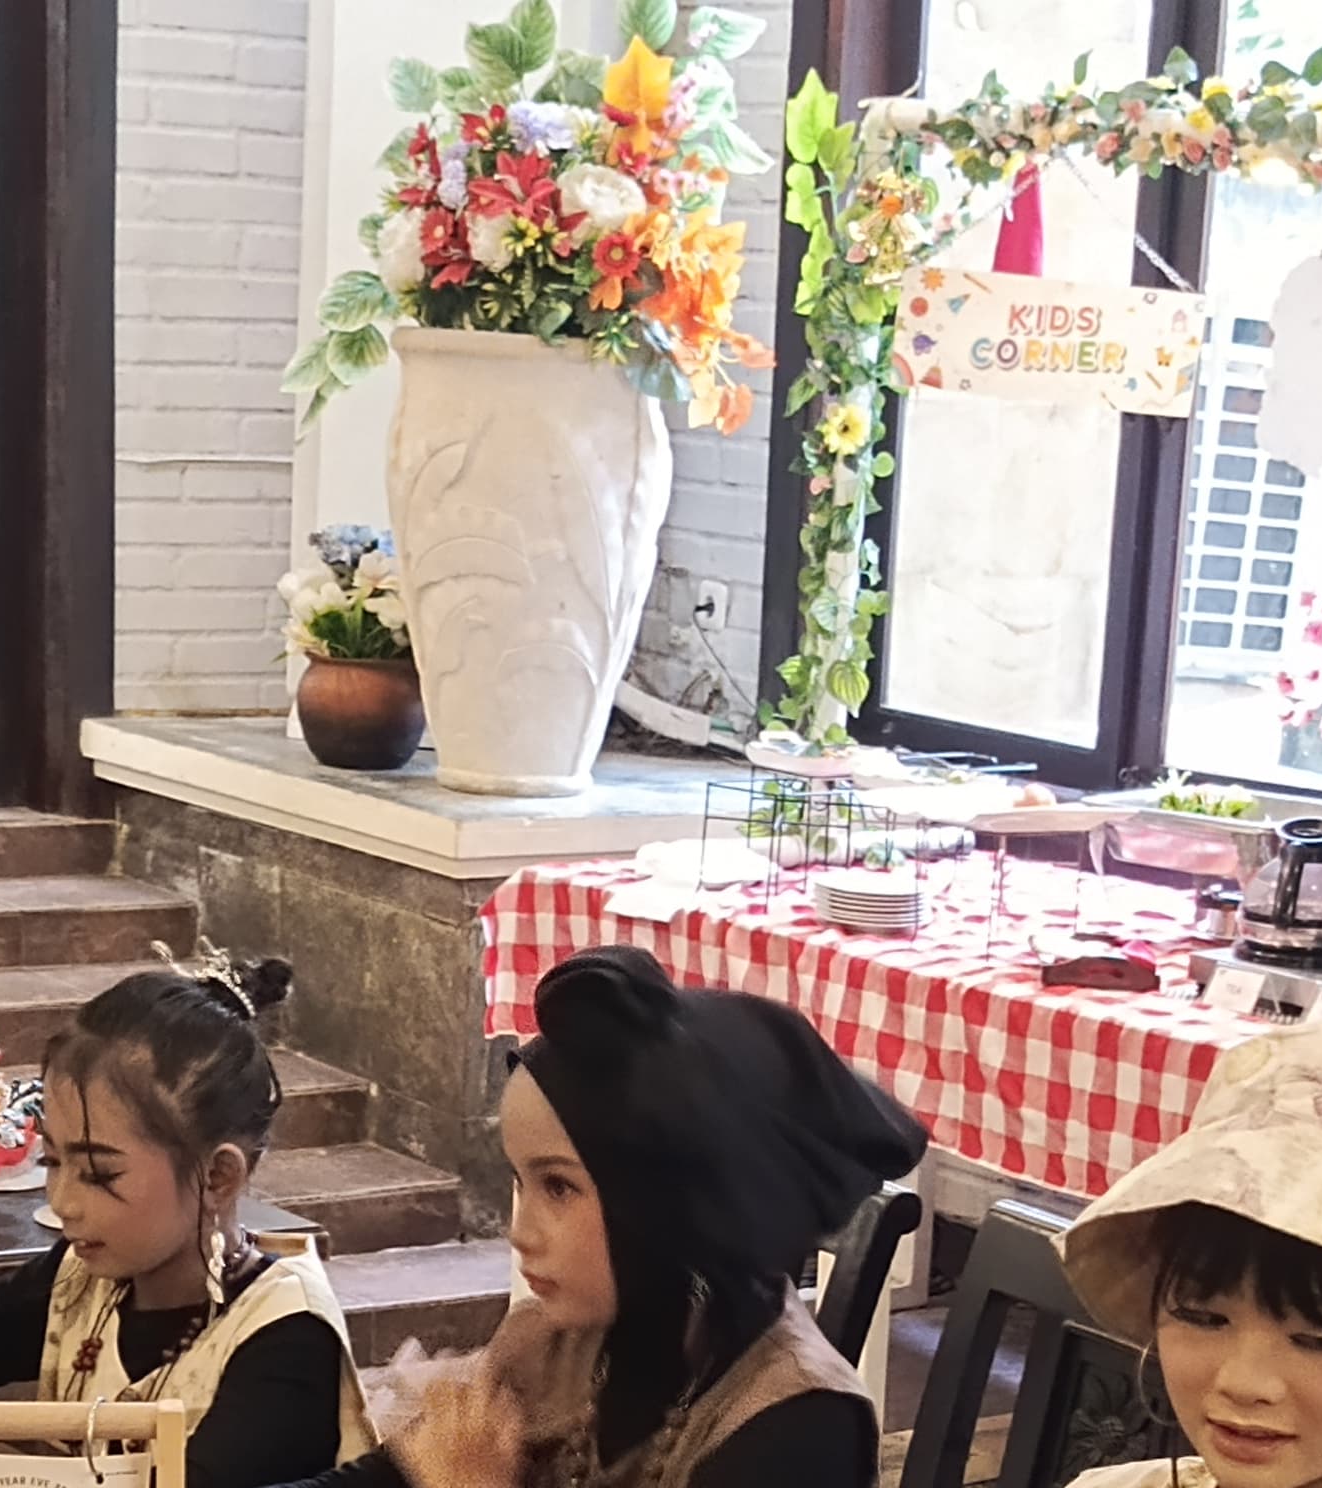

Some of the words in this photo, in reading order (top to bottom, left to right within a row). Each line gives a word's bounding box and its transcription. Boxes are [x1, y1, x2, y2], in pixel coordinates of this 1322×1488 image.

[1008, 304, 1101, 337] KIDS
[969, 337, 1126, 374] CORNER
[30, 1477, 50, 1488] EVE
